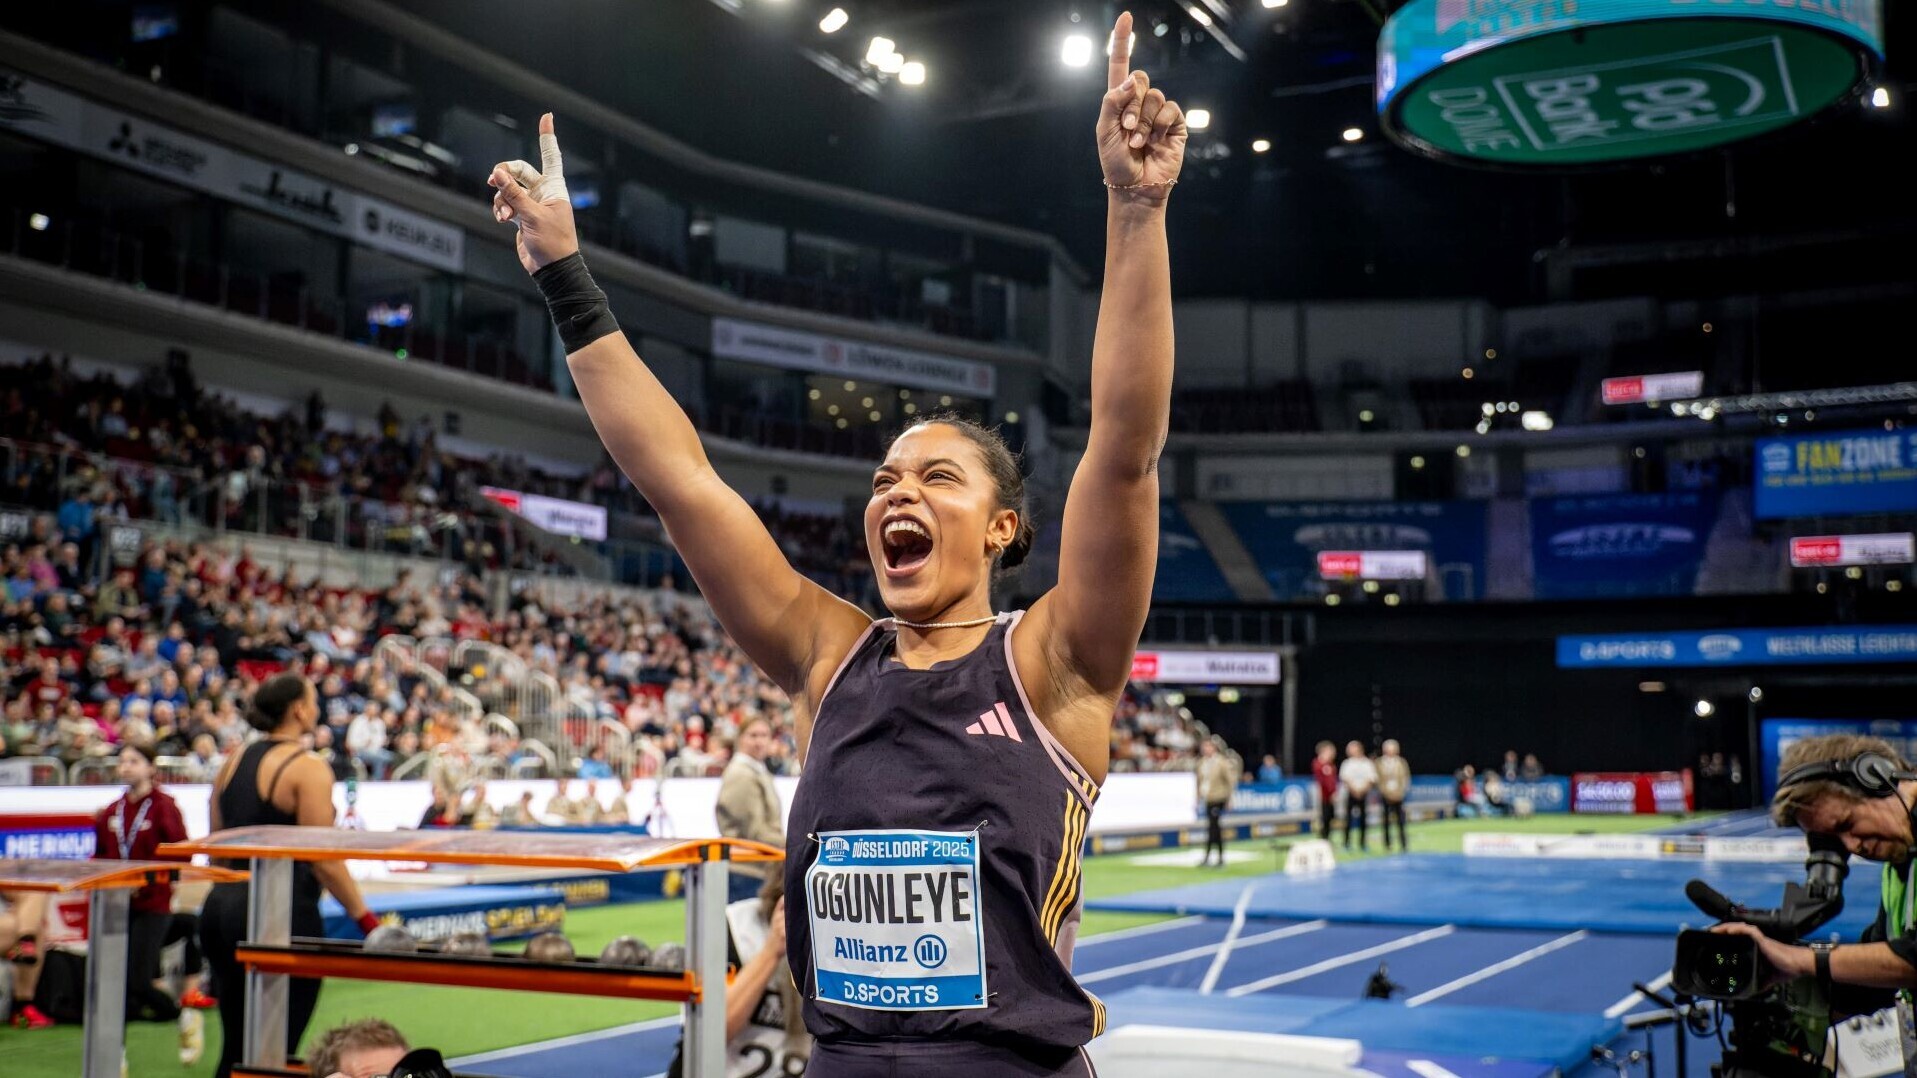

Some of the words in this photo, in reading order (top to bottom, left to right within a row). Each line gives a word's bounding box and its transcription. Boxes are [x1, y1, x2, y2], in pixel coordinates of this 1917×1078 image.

[1796, 435, 1904, 474] FANZONE
[852, 838, 929, 859] DÜSSELDORF
[932, 840, 970, 858] 2025
[812, 870, 971, 924] OGUNLEYE
[834, 936, 908, 963] Allianz
[844, 981, 940, 1005] D.SPORTS
